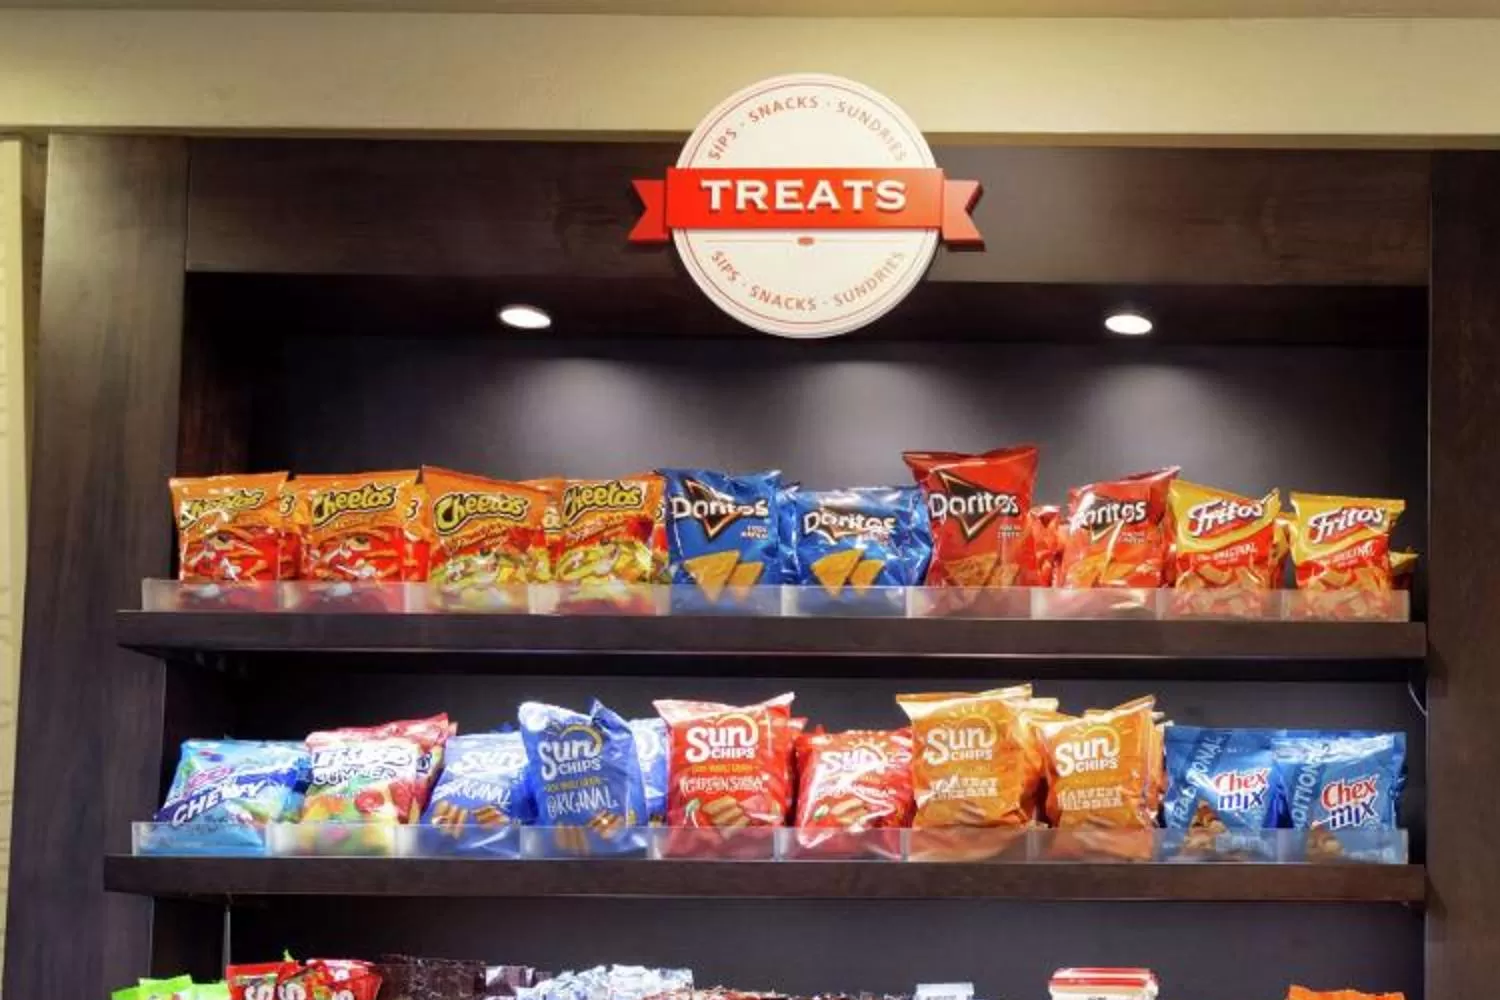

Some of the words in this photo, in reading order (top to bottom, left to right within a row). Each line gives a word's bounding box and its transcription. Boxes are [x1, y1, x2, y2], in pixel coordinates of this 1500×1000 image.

[707, 128, 738, 161] SIPS
[747, 95, 819, 123] SNACKS
[835, 100, 908, 163] SUNDRIES
[701, 179, 907, 213] TREATS
[710, 250, 739, 283] SIPS
[750, 284, 817, 312] SNACKS
[832, 250, 906, 308] SUNDRIES
[312, 483, 397, 527] Cheetos
[434, 492, 531, 536] Cheetos
[671, 496, 770, 519] Doritos
[930, 491, 1019, 517] Doritos
[1188, 494, 1266, 535] Fritos
[1308, 506, 1386, 544] Fritos
[685, 725, 759, 763] Sun
[1055, 735, 1120, 777] Sun
[1215, 767, 1272, 792] Chex
[1322, 775, 1380, 809] Chex
[1330, 798, 1380, 830] mix
